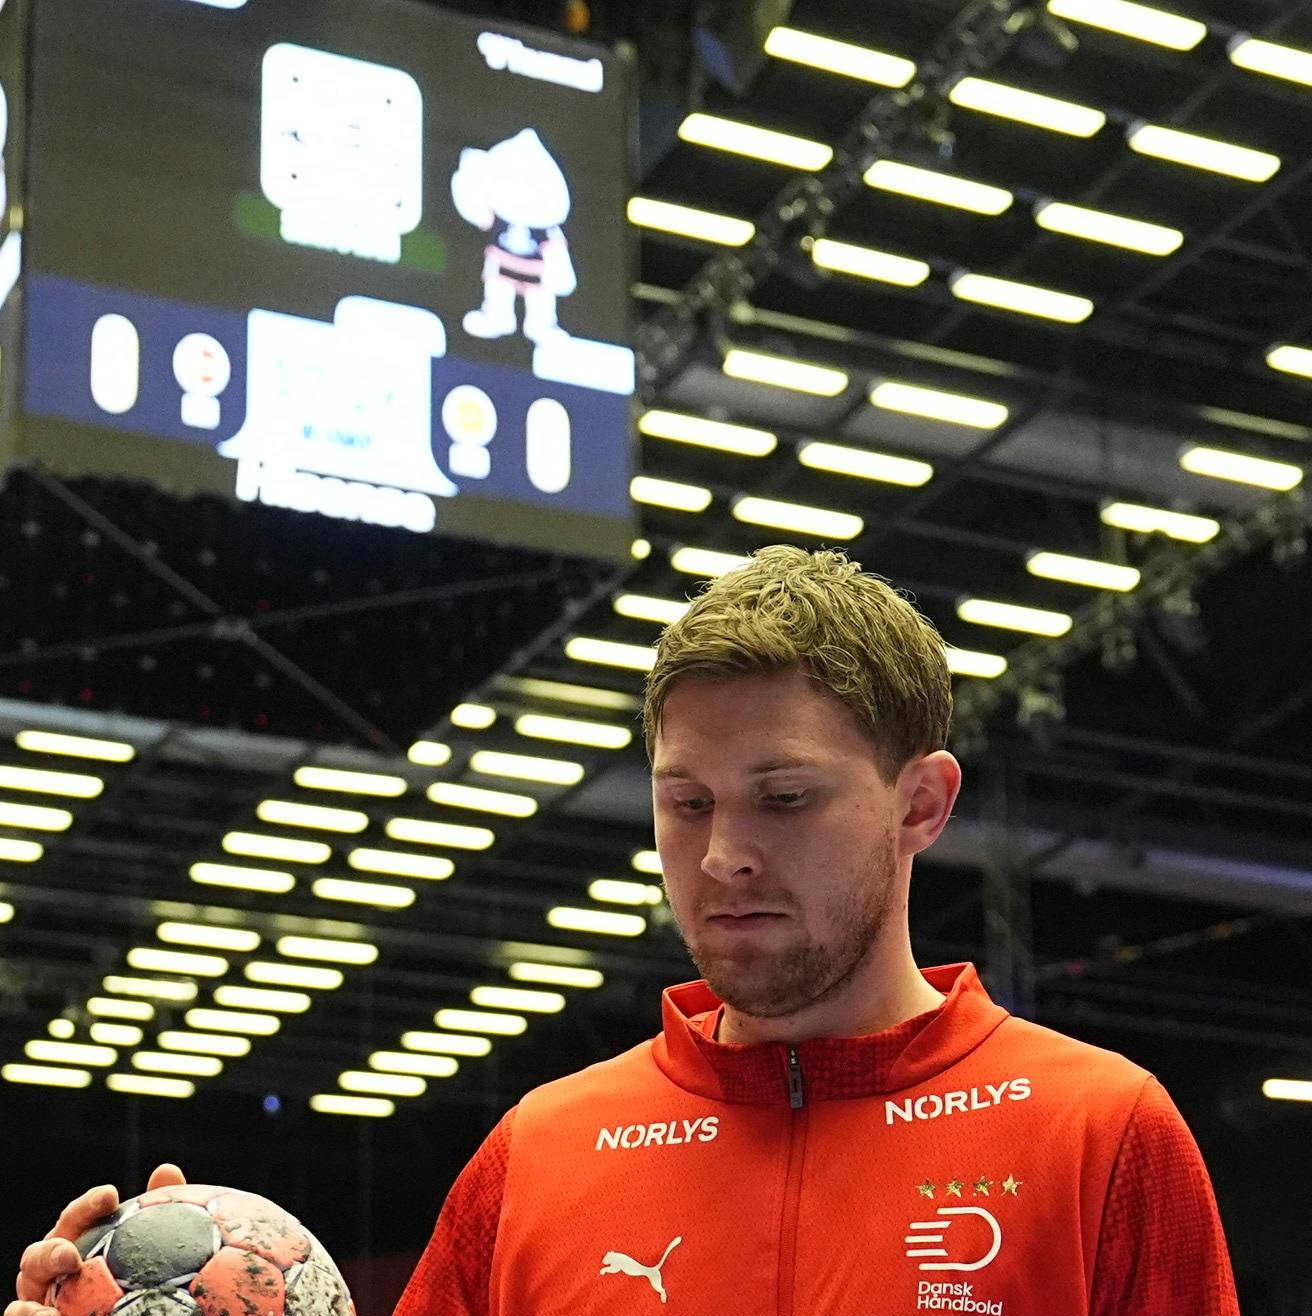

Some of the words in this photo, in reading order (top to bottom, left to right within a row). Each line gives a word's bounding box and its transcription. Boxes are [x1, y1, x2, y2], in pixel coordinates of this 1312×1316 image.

[886, 1078, 1031, 1125] NORLYS
[596, 1116, 719, 1150] NORLYS
[918, 1281, 974, 1297] Dansk
[917, 1293, 1003, 1316] Håndbold
